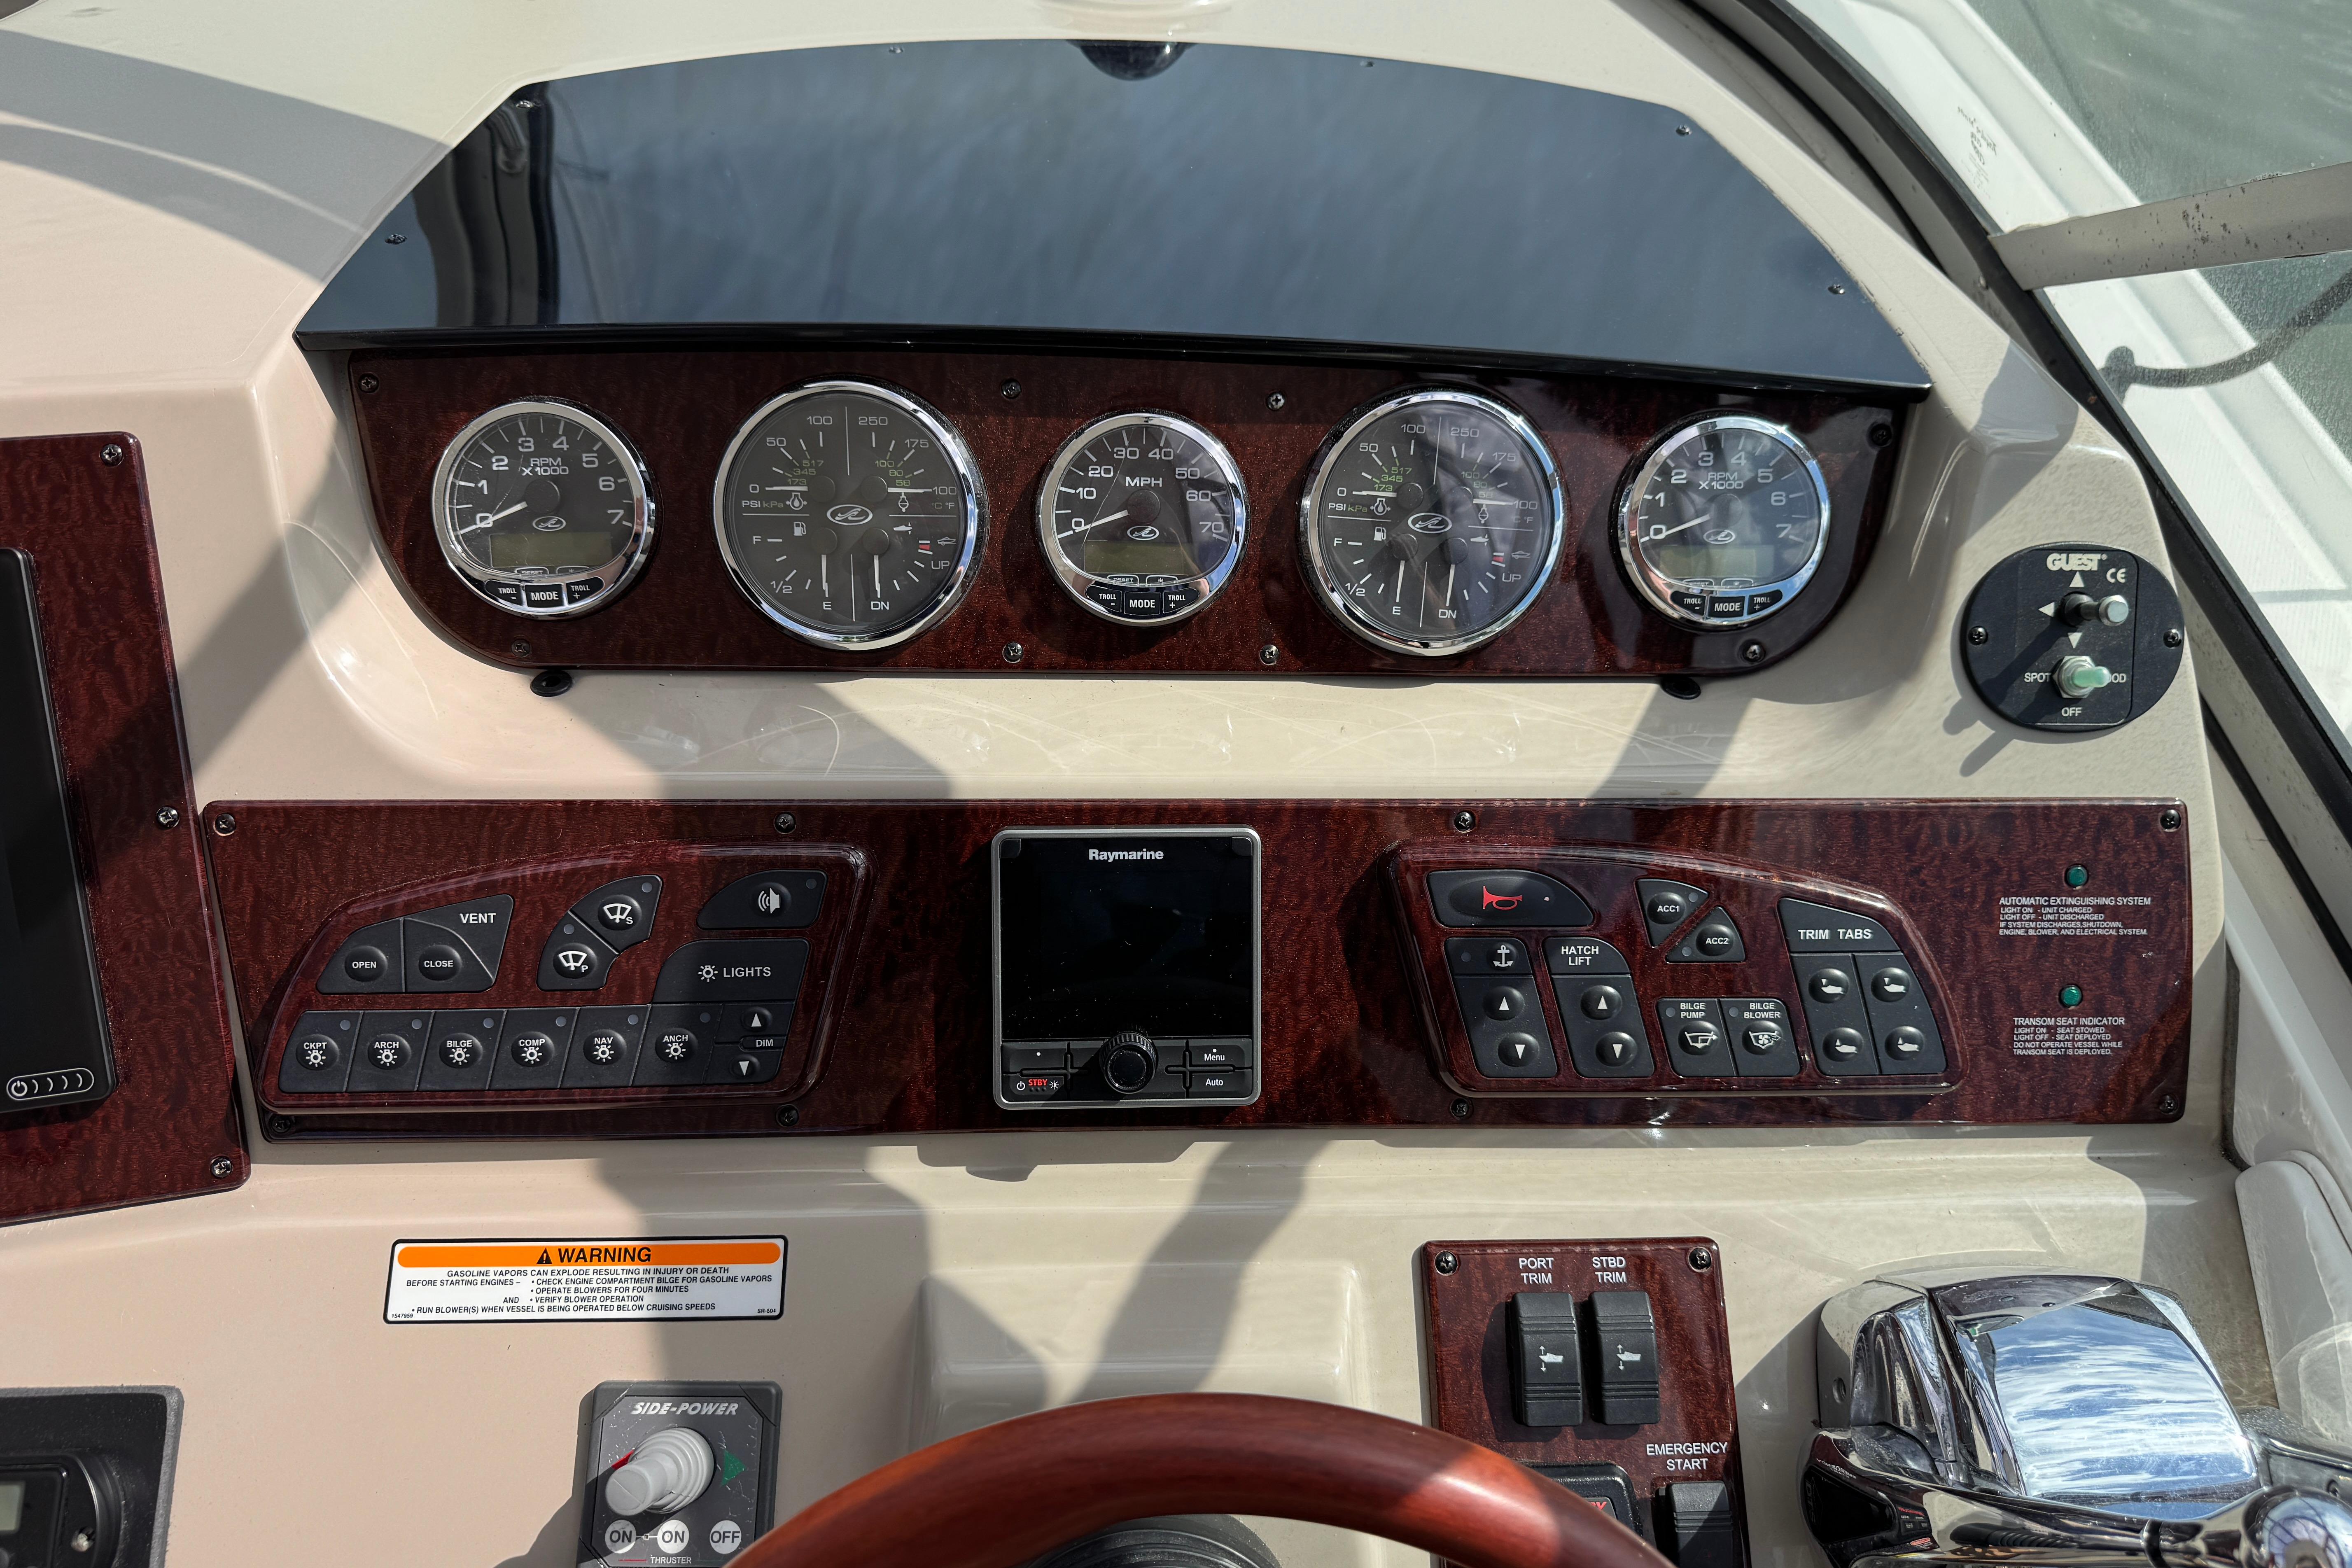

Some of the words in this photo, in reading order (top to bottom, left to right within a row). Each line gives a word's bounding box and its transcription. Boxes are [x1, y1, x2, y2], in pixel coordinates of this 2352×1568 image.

[806, 416, 833, 425] 100
[858, 416, 888, 426] 250
[766, 437, 786, 447] 50
[904, 439, 929, 448] 175
[1114, 448, 1139, 459] 30
[1148, 448, 1174, 460] 40
[530, 457, 562, 466] RPM
[1088, 466, 1114, 477] 20
[1175, 468, 1200, 479] 50
[1708, 472, 1738, 481] RPM
[1125, 477, 1162, 487] MPH
[932, 486, 957, 495] 100
[1076, 487, 1097, 499] 10
[1186, 490, 1211, 502] 60
[1199, 521, 1224, 533] 70
[931, 561, 950, 569] UP
[1502, 573, 1521, 582] UP
[2106, 568, 2126, 583] CE
[531, 591, 559, 601] MODE
[871, 601, 889, 610] DN
[1129, 600, 1155, 608] MODE
[1714, 602, 1741, 611] MODE
[1438, 610, 1456, 619] DN
[2024, 672, 2051, 683] SPOT
[2061, 707, 2082, 716] OFF
[1089, 849, 1164, 862] Raymarine
[2116, 897, 2151, 905] SYSTEM
[460, 913, 496, 924] VENT
[1798, 929, 1829, 940] TRIM
[1838, 929, 1872, 939] TABS
[1561, 946, 1599, 955] HATCH
[352, 961, 377, 969] OPEN
[423, 960, 454, 968] CLOSE
[1568, 957, 1591, 966] LIFT
[723, 966, 771, 978] LIGHTS
[1744, 1011, 1780, 1019] BLOWER
[663, 1035, 688, 1043] ANCH
[756, 1038, 773, 1048] DIM
[303, 1042, 327, 1050] CKPT
[1204, 1053, 1225, 1062] Menu
[1205, 1078, 1223, 1086] Auto
[558, 1247, 651, 1263] WARNING
[1519, 1258, 1554, 1269] PORT
[1592, 1257, 1626, 1268] STBD
[1521, 1272, 1552, 1284] TRIM
[1595, 1272, 1626, 1283] TRIM
[435, 1306, 479, 1314] BLOWER(S)
[630, 1402, 739, 1415] SIDE-POWER
[1646, 1442, 1728, 1456] EMERGENCY
[1666, 1459, 1708, 1470] START
[609, 1530, 632, 1543] ON
[662, 1530, 685, 1543] ON
[711, 1531, 740, 1543] OFF
